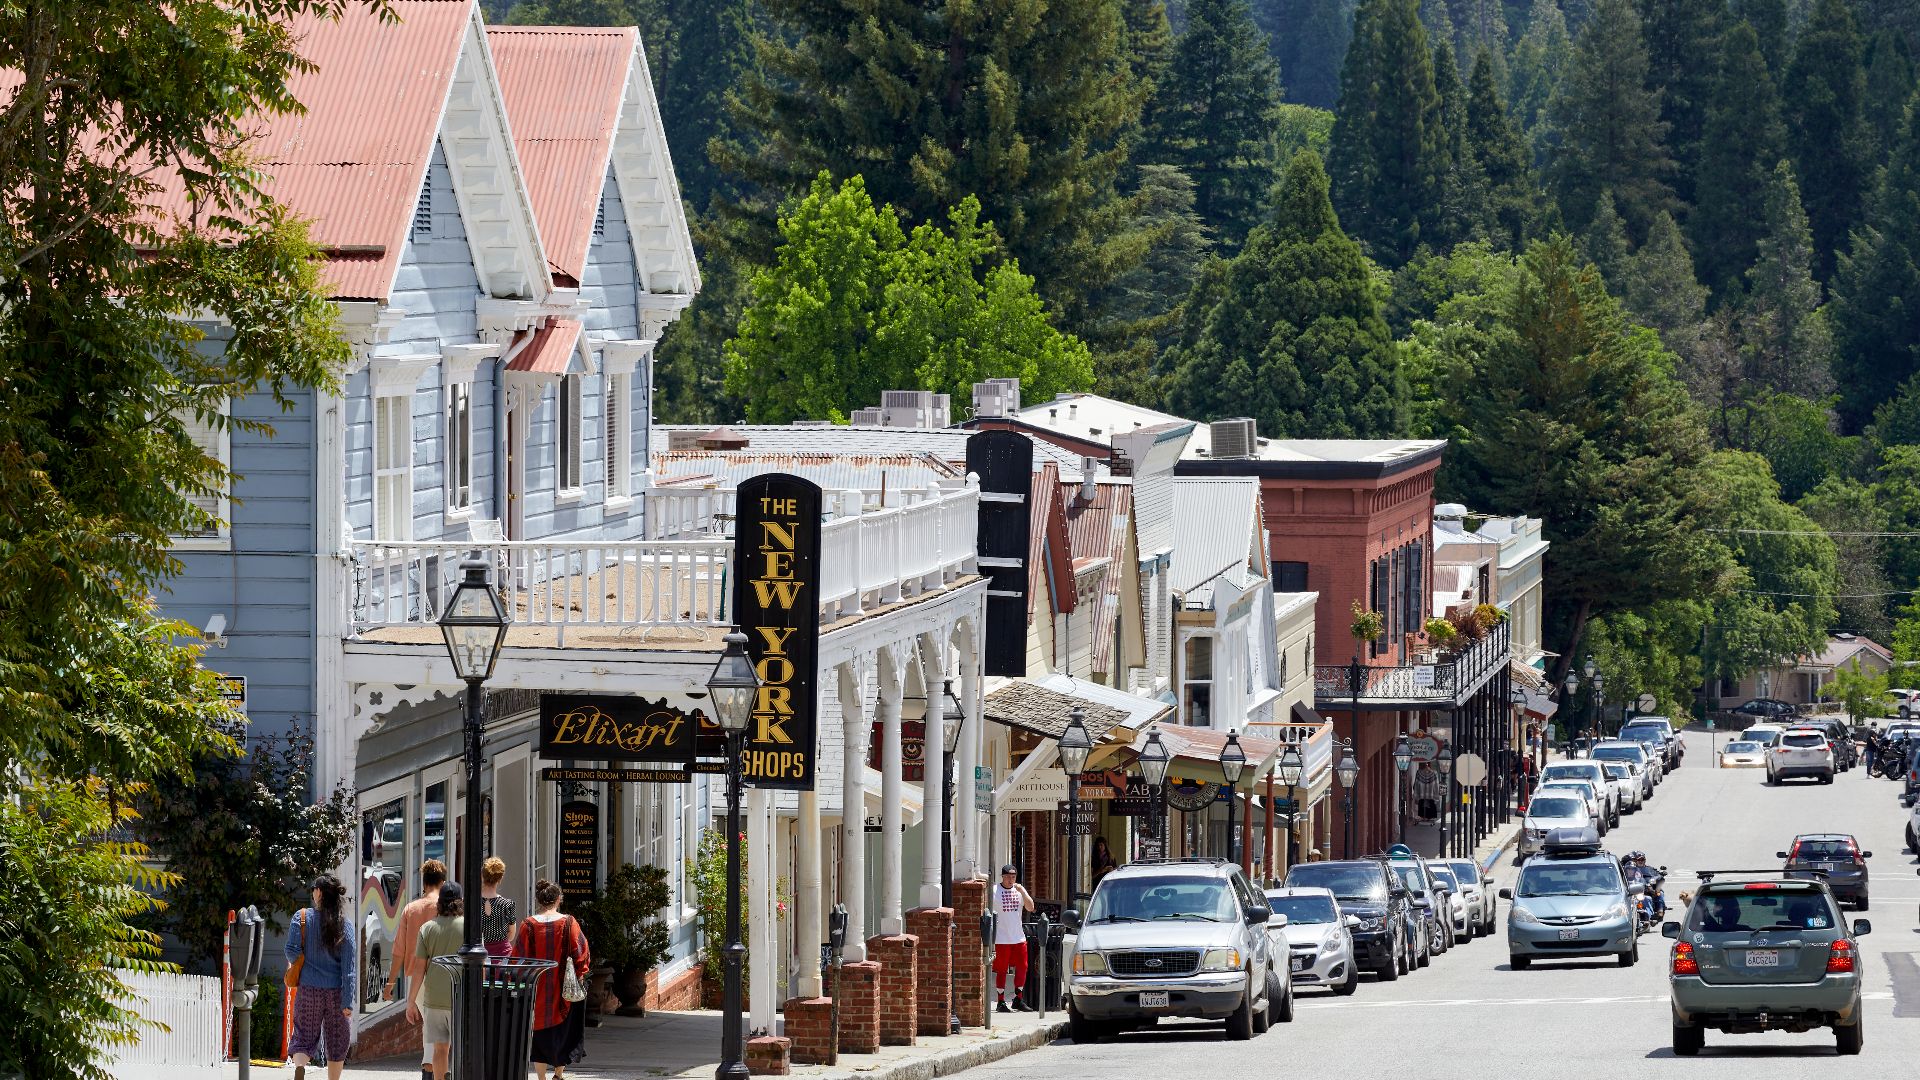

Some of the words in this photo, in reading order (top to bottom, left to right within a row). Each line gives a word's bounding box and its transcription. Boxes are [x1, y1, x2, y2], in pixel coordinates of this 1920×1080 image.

[760, 497, 797, 515] THE
[750, 521, 804, 609] NEW
[752, 627, 798, 744] YORK
[550, 705, 685, 752] Elixart
[741, 750, 804, 778] SHOPS
[548, 770, 562, 779] ART
[564, 770, 596, 780] TASTING
[597, 771, 619, 780] ROOM
[626, 772, 654, 780] HERBAL
[655, 772, 686, 781] LOUNGE
[1085, 788, 1105, 797] YORK
[1083, 802, 1093, 811] TO
[565, 812, 594, 823] Shops
[1061, 813, 1095, 823] PAKING
[1065, 824, 1090, 834] SOPS
